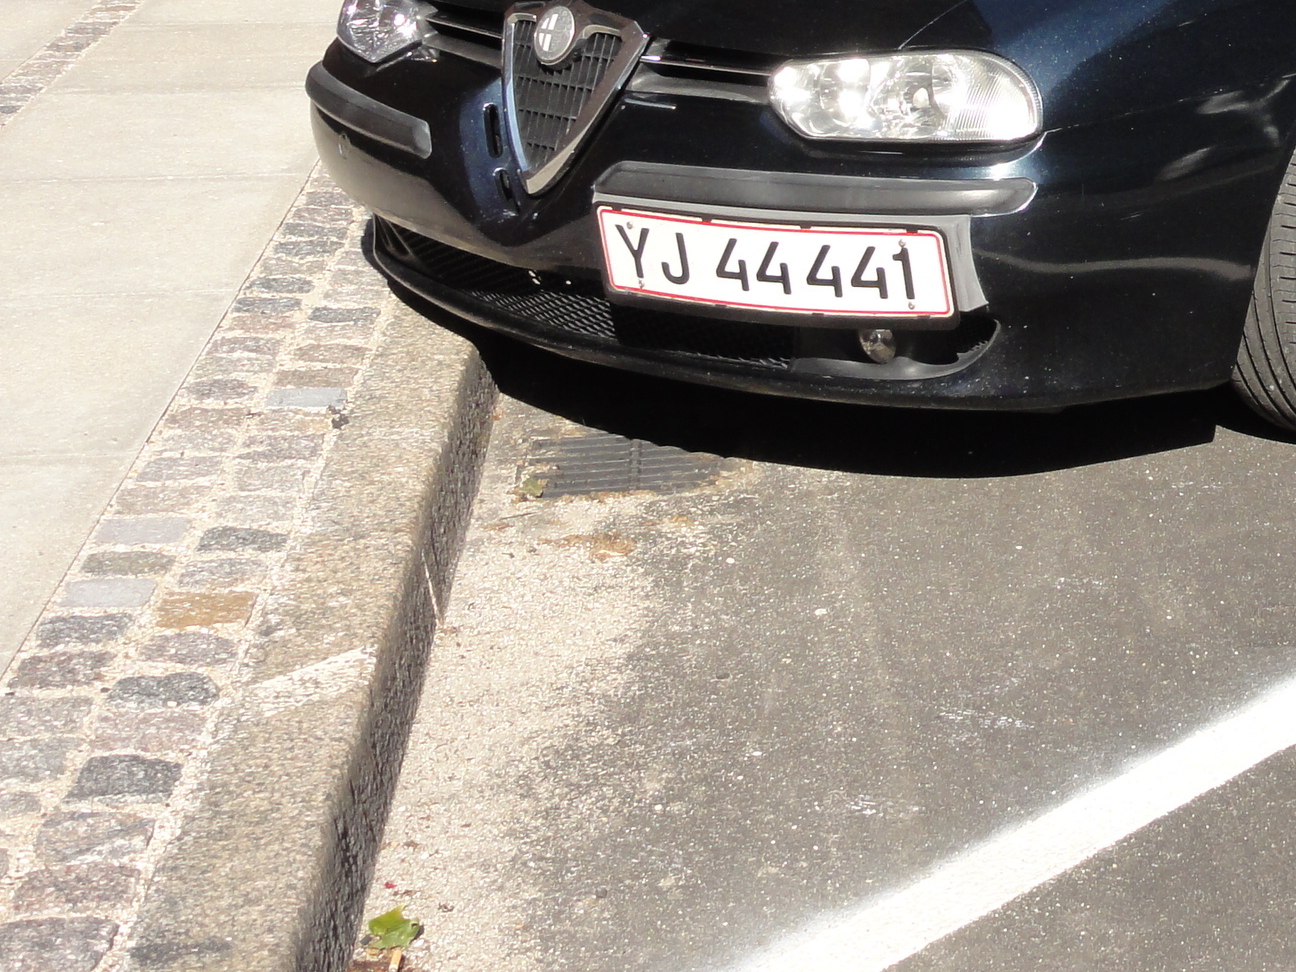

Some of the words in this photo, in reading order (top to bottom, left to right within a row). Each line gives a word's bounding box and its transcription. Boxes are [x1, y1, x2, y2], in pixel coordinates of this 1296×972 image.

[614, 223, 691, 285] YJ
[715, 237, 792, 296] 44
[805, 244, 916, 300] 441
